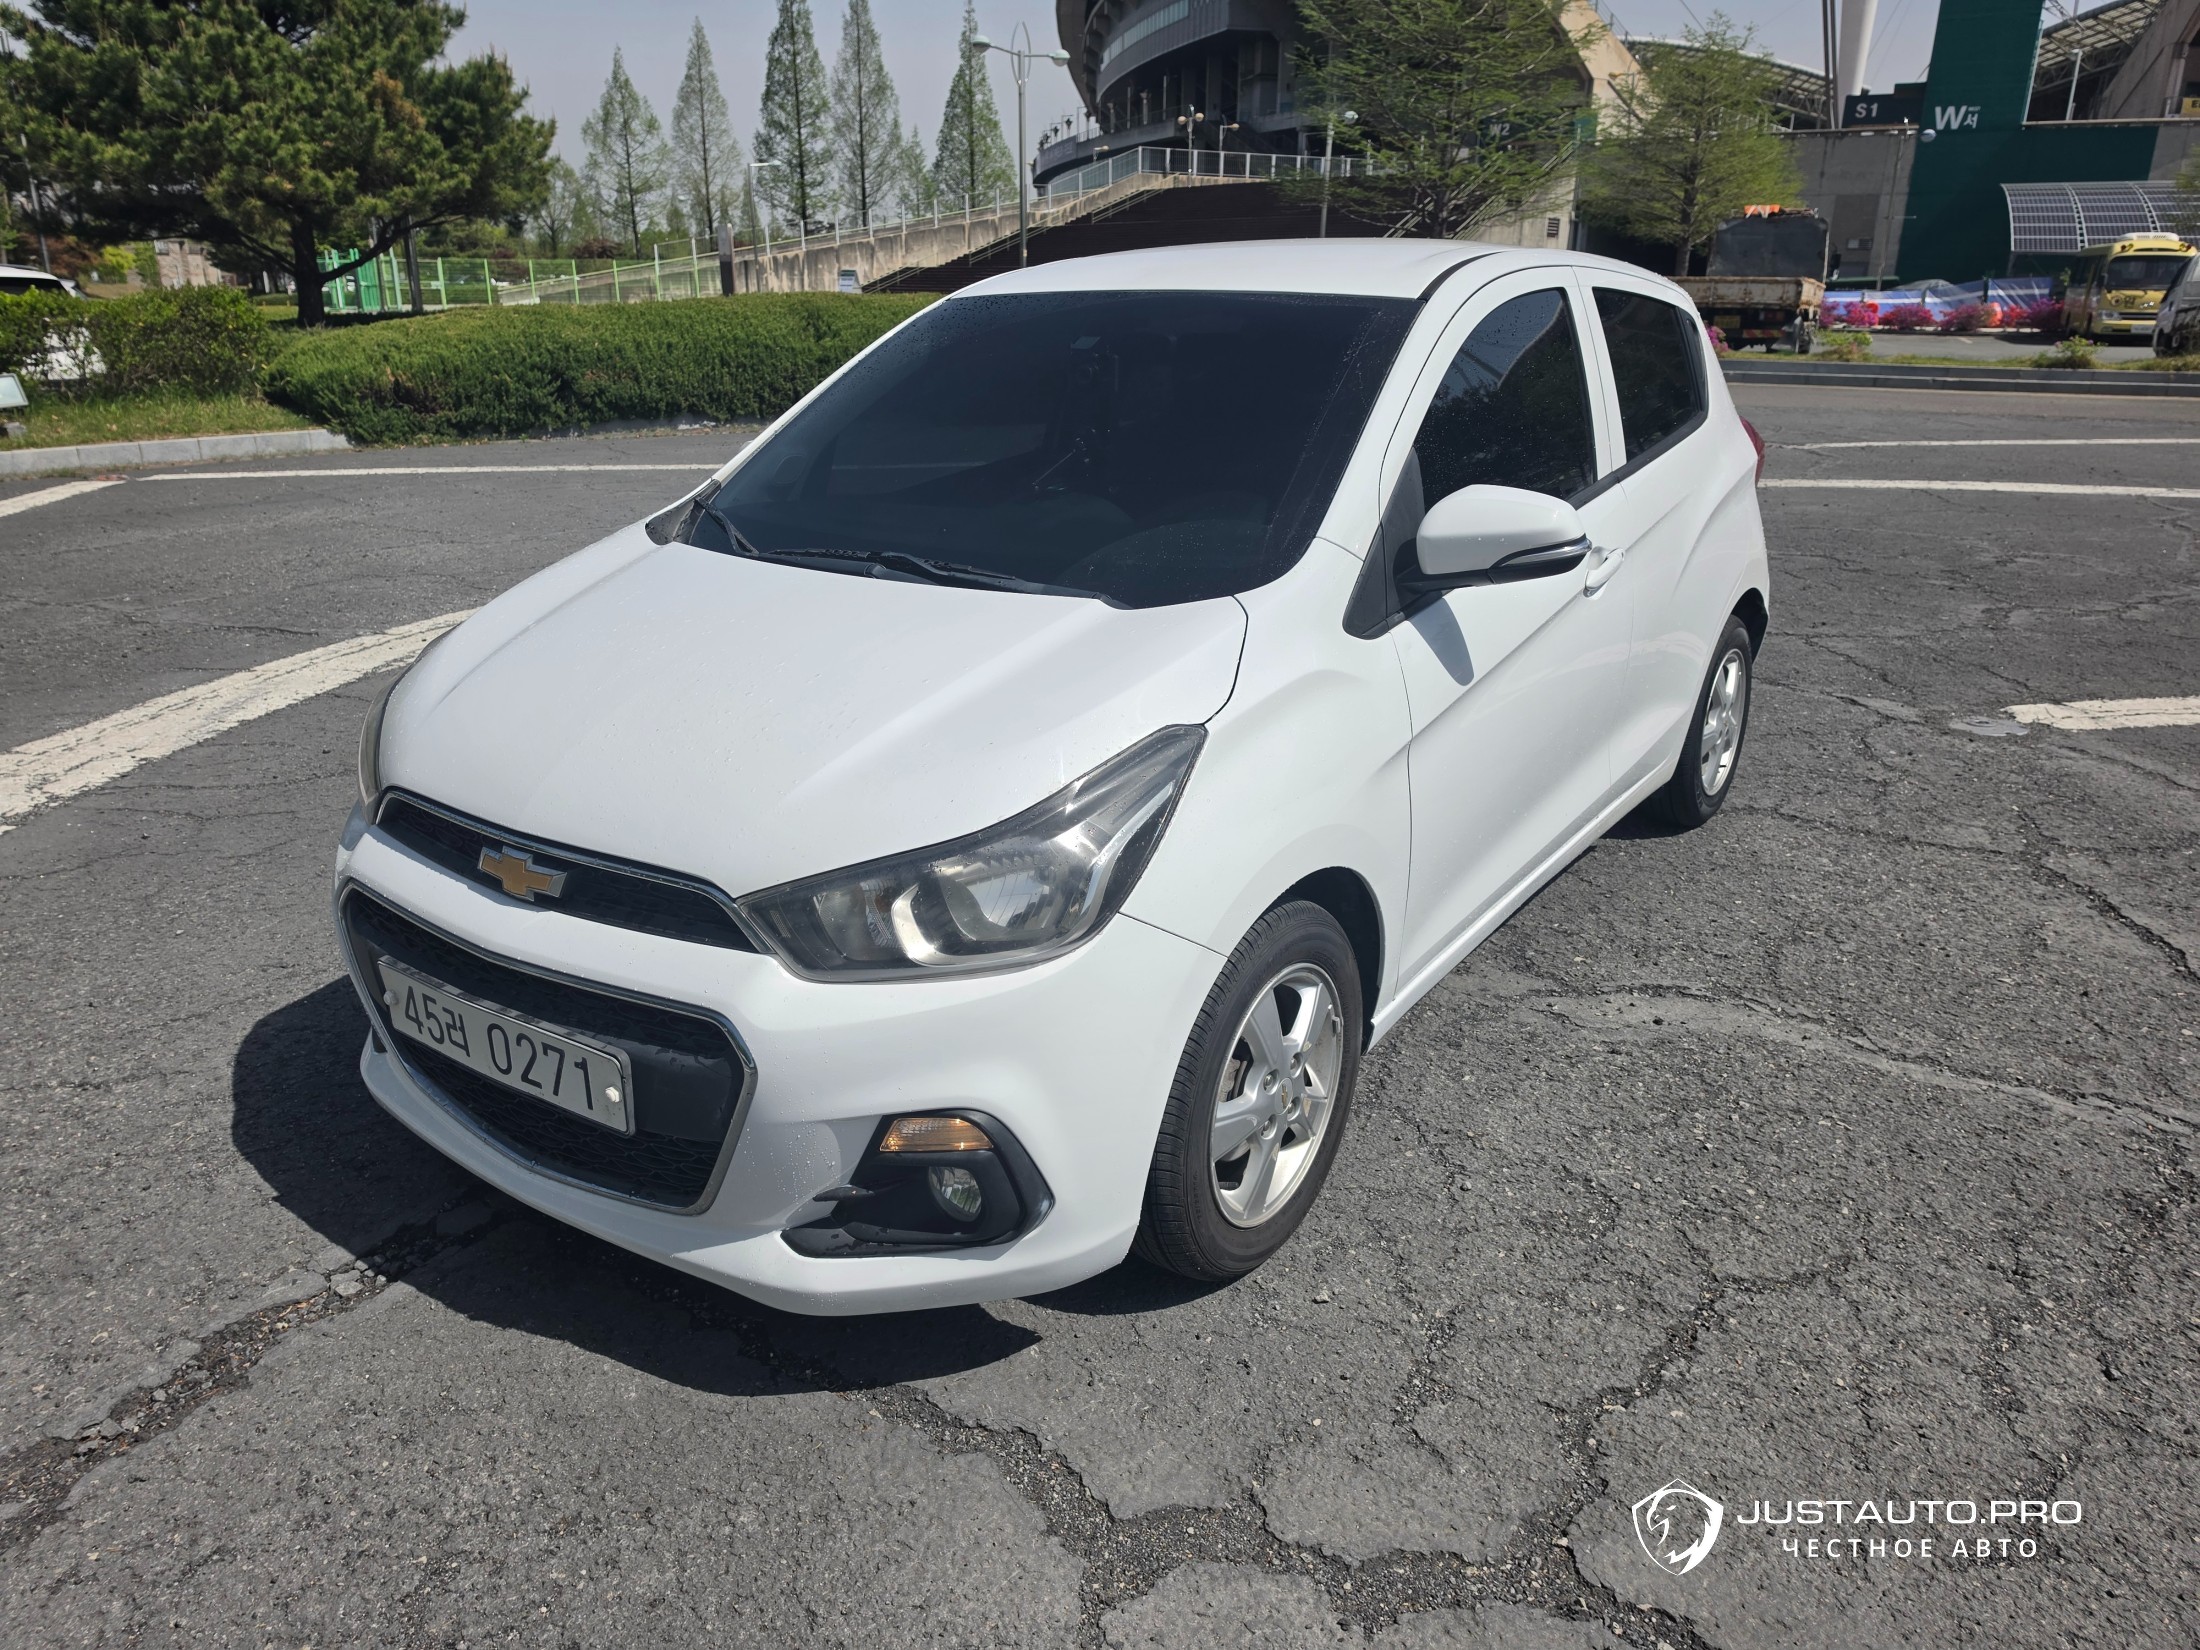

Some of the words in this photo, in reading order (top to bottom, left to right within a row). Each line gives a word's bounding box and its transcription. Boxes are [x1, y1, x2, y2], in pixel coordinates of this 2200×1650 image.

[1855, 102, 1878, 118] S1
[404, 985, 470, 1058] 45러
[486, 1022, 594, 1111] 0271
